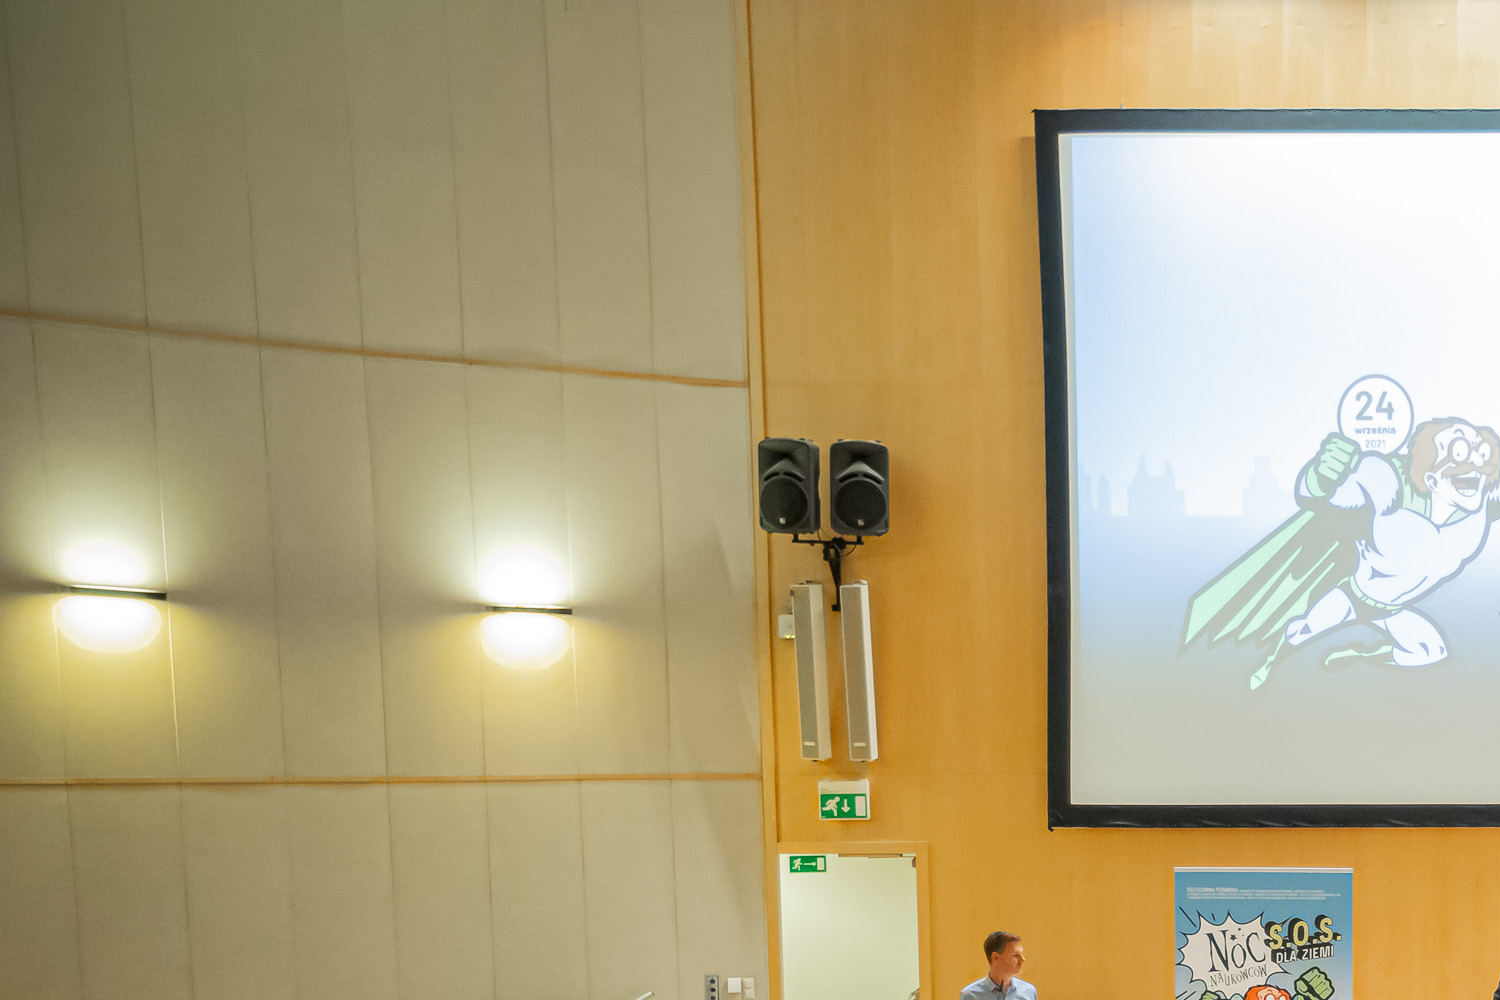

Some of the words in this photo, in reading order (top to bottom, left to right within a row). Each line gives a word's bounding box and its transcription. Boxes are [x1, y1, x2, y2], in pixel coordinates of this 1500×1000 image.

[1355, 390, 1394, 420] 24
[1354, 425, 1396, 434] września
[1366, 439, 1386, 448] 2021
[1267, 916, 1342, 949] S.O.S.
[1276, 950, 1297, 963] DLA
[1302, 945, 1334, 960] ZIEMI
